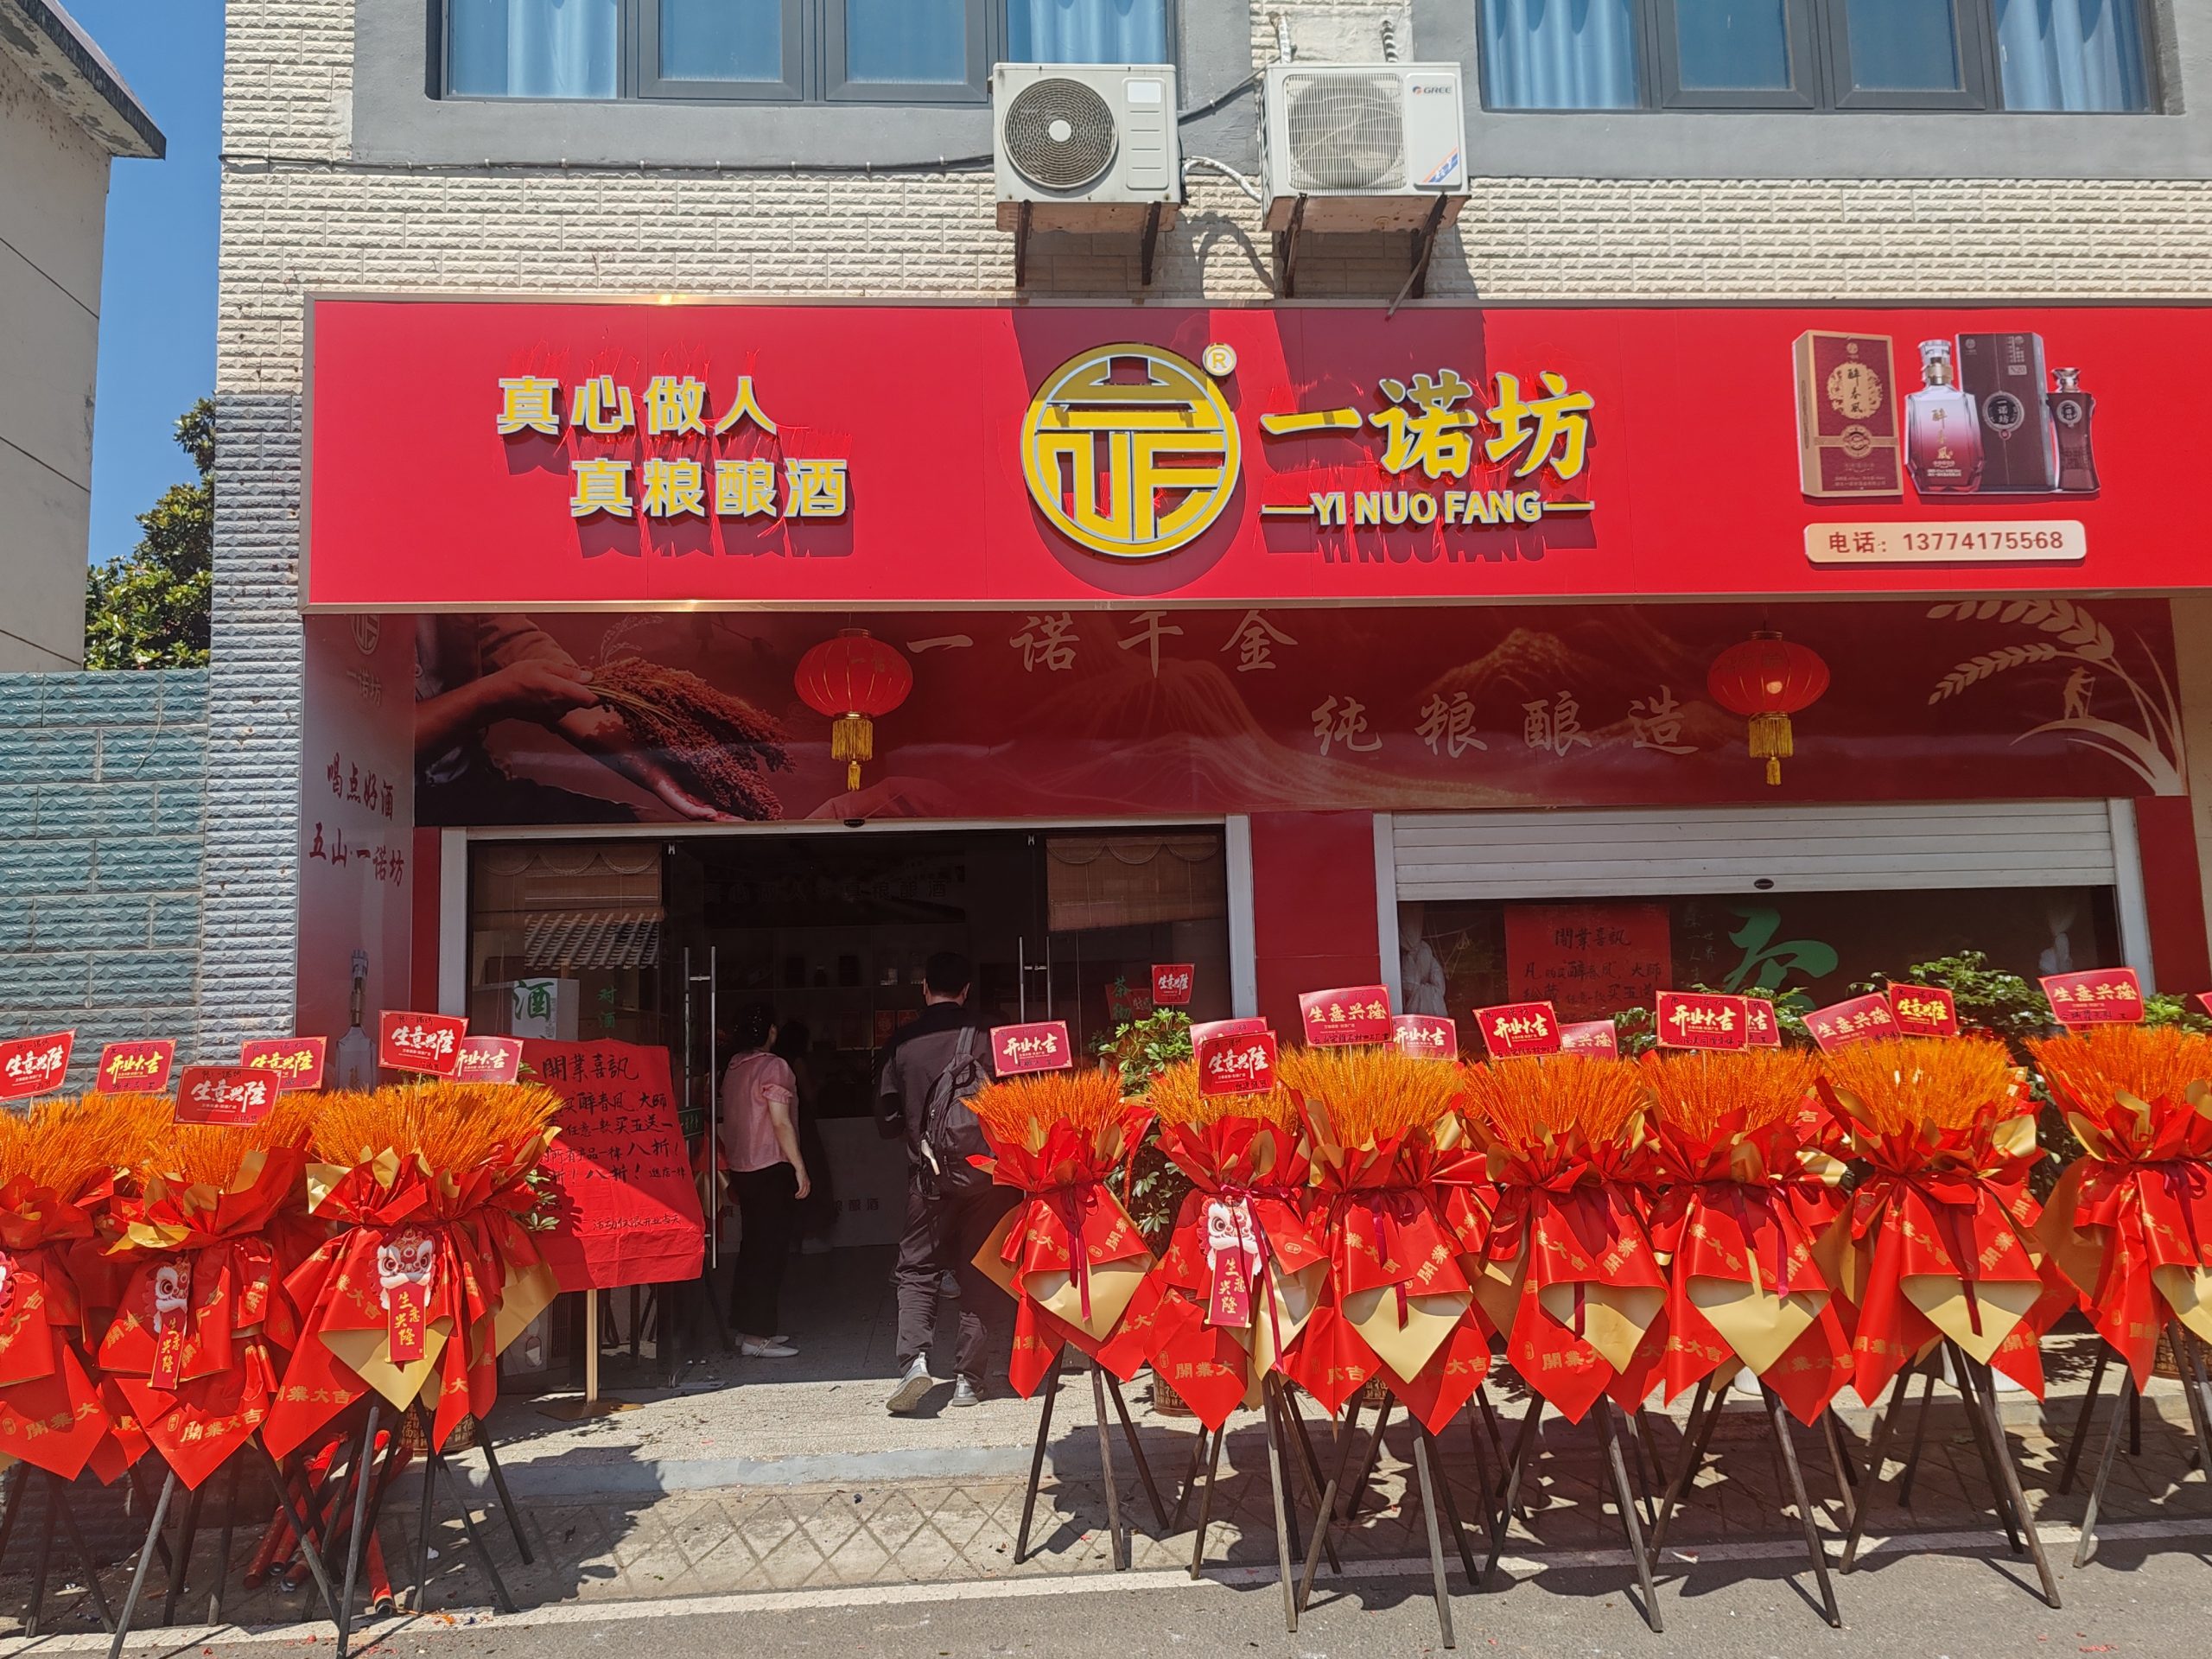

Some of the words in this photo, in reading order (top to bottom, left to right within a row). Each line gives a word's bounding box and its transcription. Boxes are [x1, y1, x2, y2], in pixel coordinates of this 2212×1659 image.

[497, 375, 777, 435] 真心做人
[1261, 368, 1595, 480] 一诺坊
[571, 458, 847, 518] 真粮酿酒
[1310, 493, 1346, 525] YI
[1354, 492, 1436, 525] NUO
[1445, 490, 1543, 524] FANG
[907, 610, 1298, 679] 一诺千金
[346, 667, 383, 708] 一诺坊
[1311, 683, 1700, 759] 纯粮酿造
[326, 751, 395, 822] 喝点好酒
[512, 980, 555, 1021] 酒
[2053, 981, 2138, 1002] 生意兴隆
[1308, 1000, 1387, 1023] 生意兴隆
[1669, 1005, 1737, 1037] 开业大吉
[1817, 1006, 1891, 1039] 生意兴隆
[1897, 998, 1949, 1026] 生意兴隆
[391, 1025, 455, 1060] 生意兴隆
[1393, 1027, 1446, 1052] 开业大吉
[1493, 1013, 1549, 1048] 开业大吉
[5, 1045, 65, 1079] 生意兴隆
[250, 1050, 314, 1078] 生意兴隆
[1003, 1033, 1058, 1065] 开业大吉
[1208, 1045, 1269, 1079] 生意兴隆
[106, 1052, 164, 1084] 开业大吉
[191, 1078, 267, 1113] 生意兴隆
[1416, 1243, 1451, 1286] 開業
[1174, 1359, 1236, 1381] 開業大
[180, 1408, 264, 1444] 開業大吉
